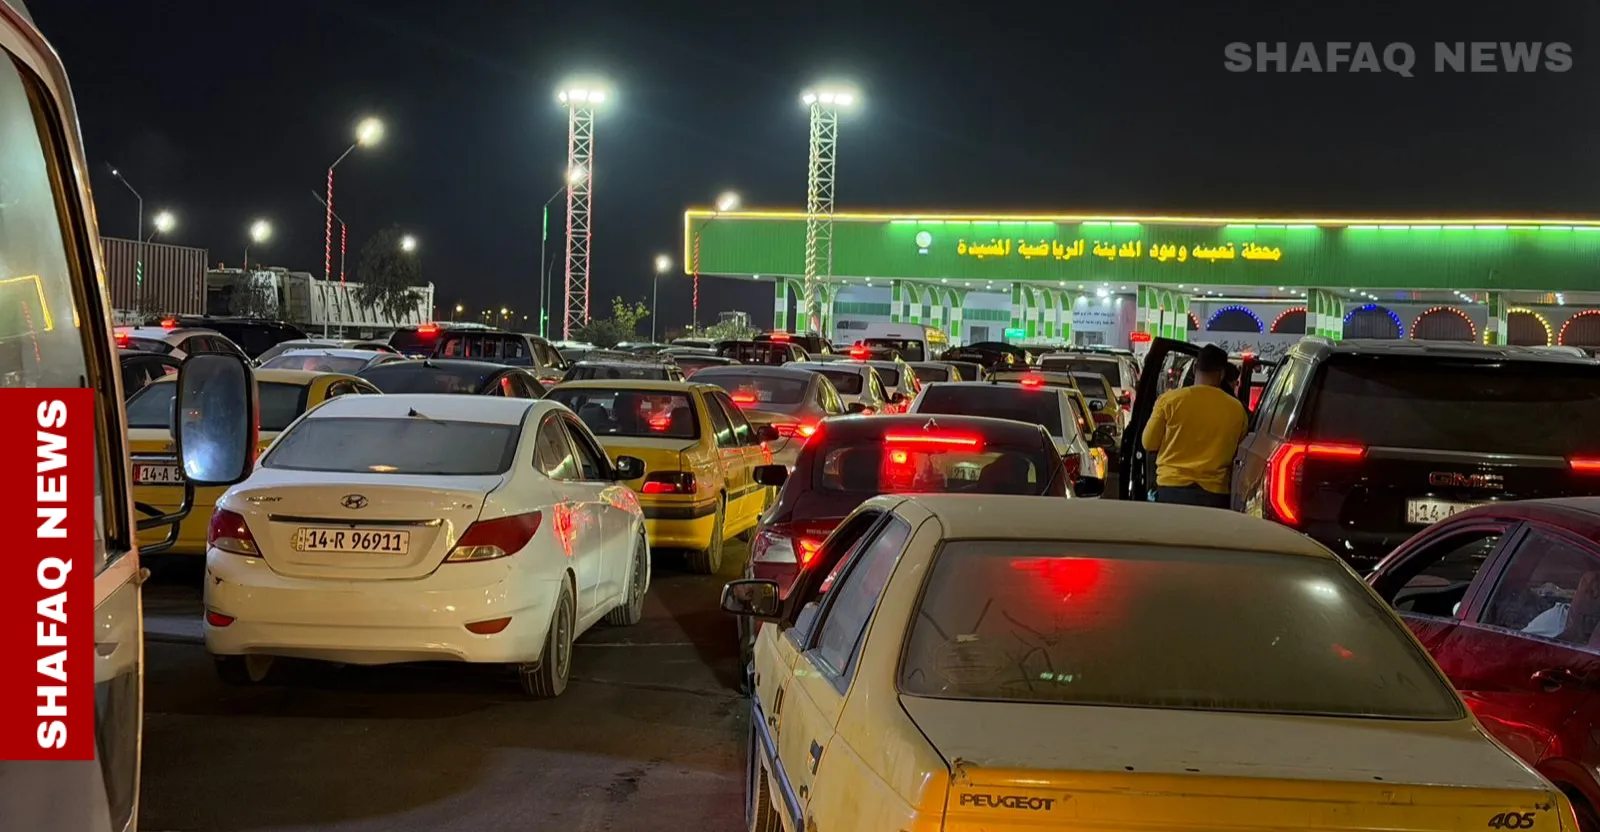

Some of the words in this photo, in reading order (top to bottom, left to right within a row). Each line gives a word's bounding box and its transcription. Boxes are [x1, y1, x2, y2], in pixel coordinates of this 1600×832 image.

[1018, 239, 1084, 260] الرياضية
[1093, 240, 1141, 261] المدينة
[1241, 242, 1281, 260] محطة
[1429, 472, 1503, 489] GMC
[351, 532, 401, 551] 96911
[960, 793, 1055, 811] PEUGEOT
[1488, 812, 1536, 829] 405
